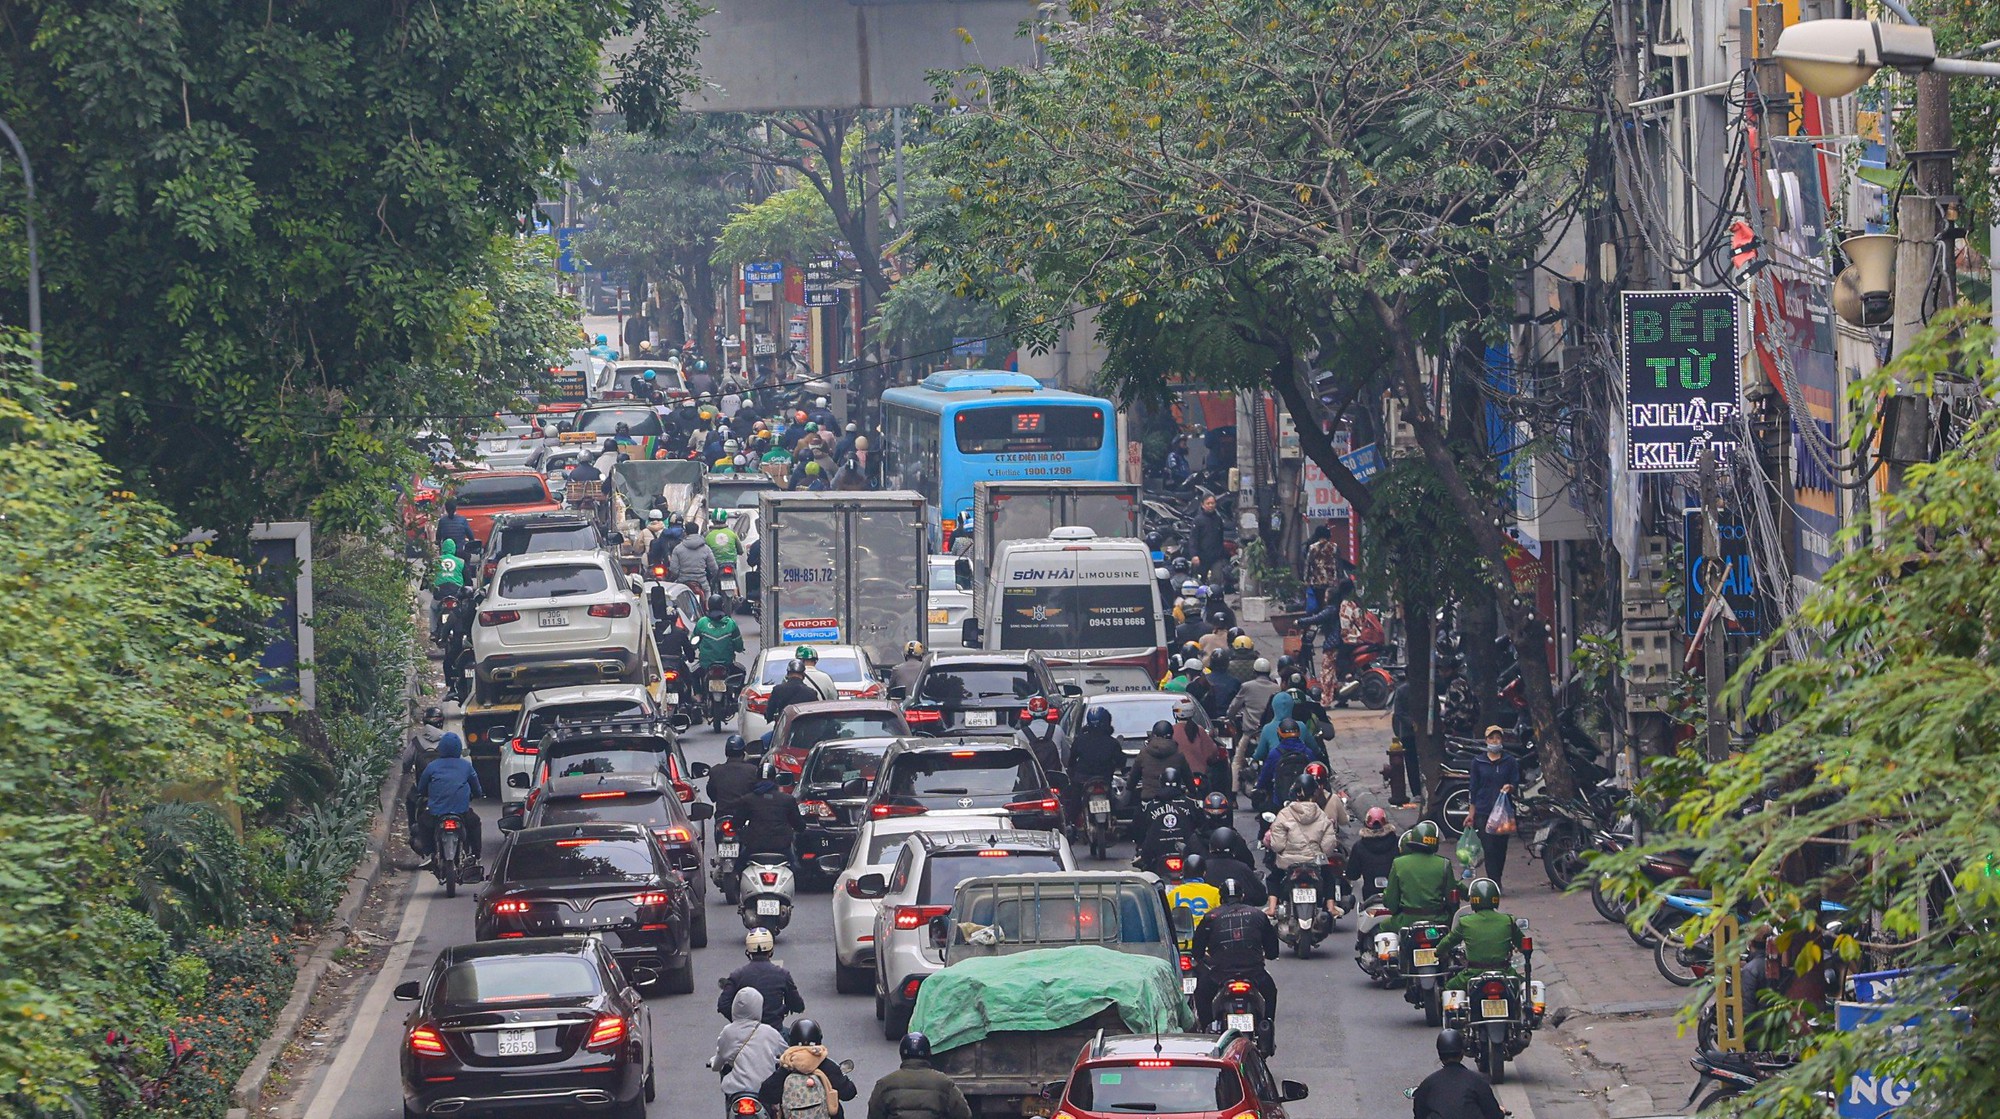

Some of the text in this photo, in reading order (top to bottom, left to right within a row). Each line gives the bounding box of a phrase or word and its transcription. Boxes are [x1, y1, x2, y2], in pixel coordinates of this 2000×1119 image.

[1633, 296, 1733, 343] BẾP
[1645, 347, 1717, 390] TỪ
[1632, 396, 1737, 431] NHẬP
[1024, 467, 1072, 475] 1900.1296
[783, 568, 833, 583] 29H-851.72
[1013, 569, 1045, 581] SƠN
[1079, 571, 1140, 579] LIMOUSINE
[787, 619, 834, 627] AIRPORT
[1089, 617, 1146, 627] 0943 59 6666
[1175, 891, 1208, 916] be
[506, 1029, 526, 1041] 30F
[499, 1041, 535, 1054] 526.59
